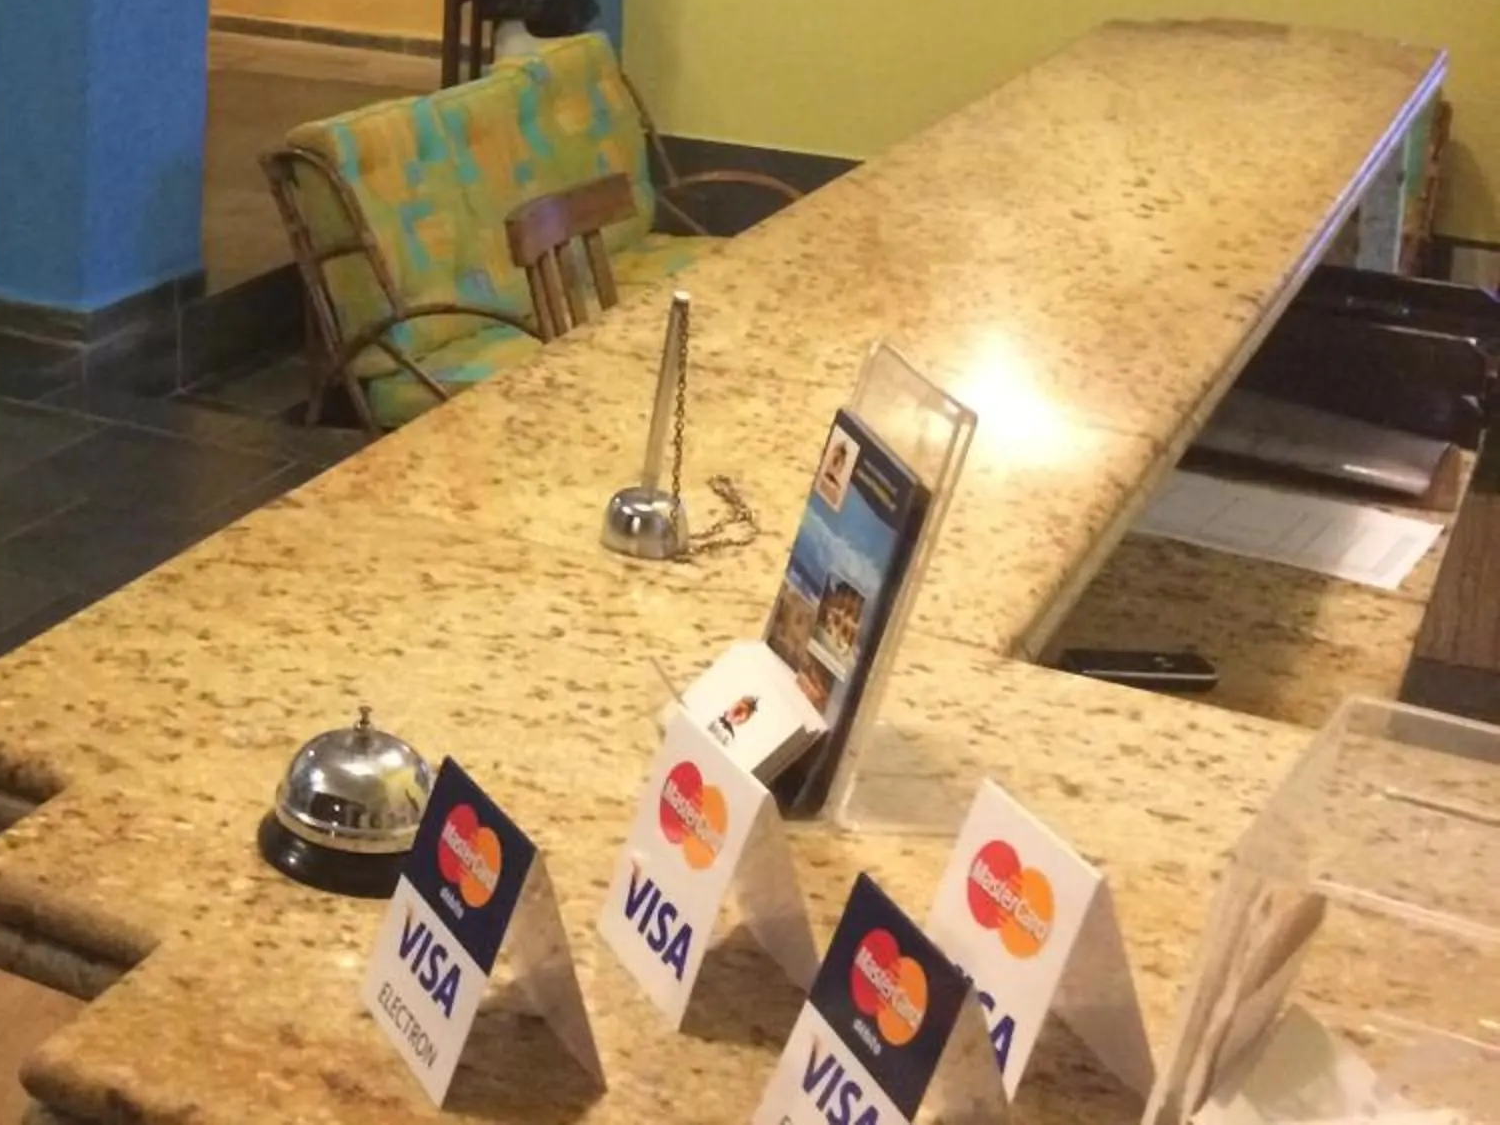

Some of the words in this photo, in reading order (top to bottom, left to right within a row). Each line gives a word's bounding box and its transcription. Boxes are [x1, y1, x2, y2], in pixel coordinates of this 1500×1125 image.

[441, 819, 499, 892] MasterCard
[661, 779, 727, 853] MasterCard
[625, 859, 693, 982] VISA
[970, 857, 1047, 941] MasterCard
[399, 911, 461, 1018] VISA
[854, 946, 922, 1032] MasterCard
[377, 980, 438, 1070] ELECTRON
